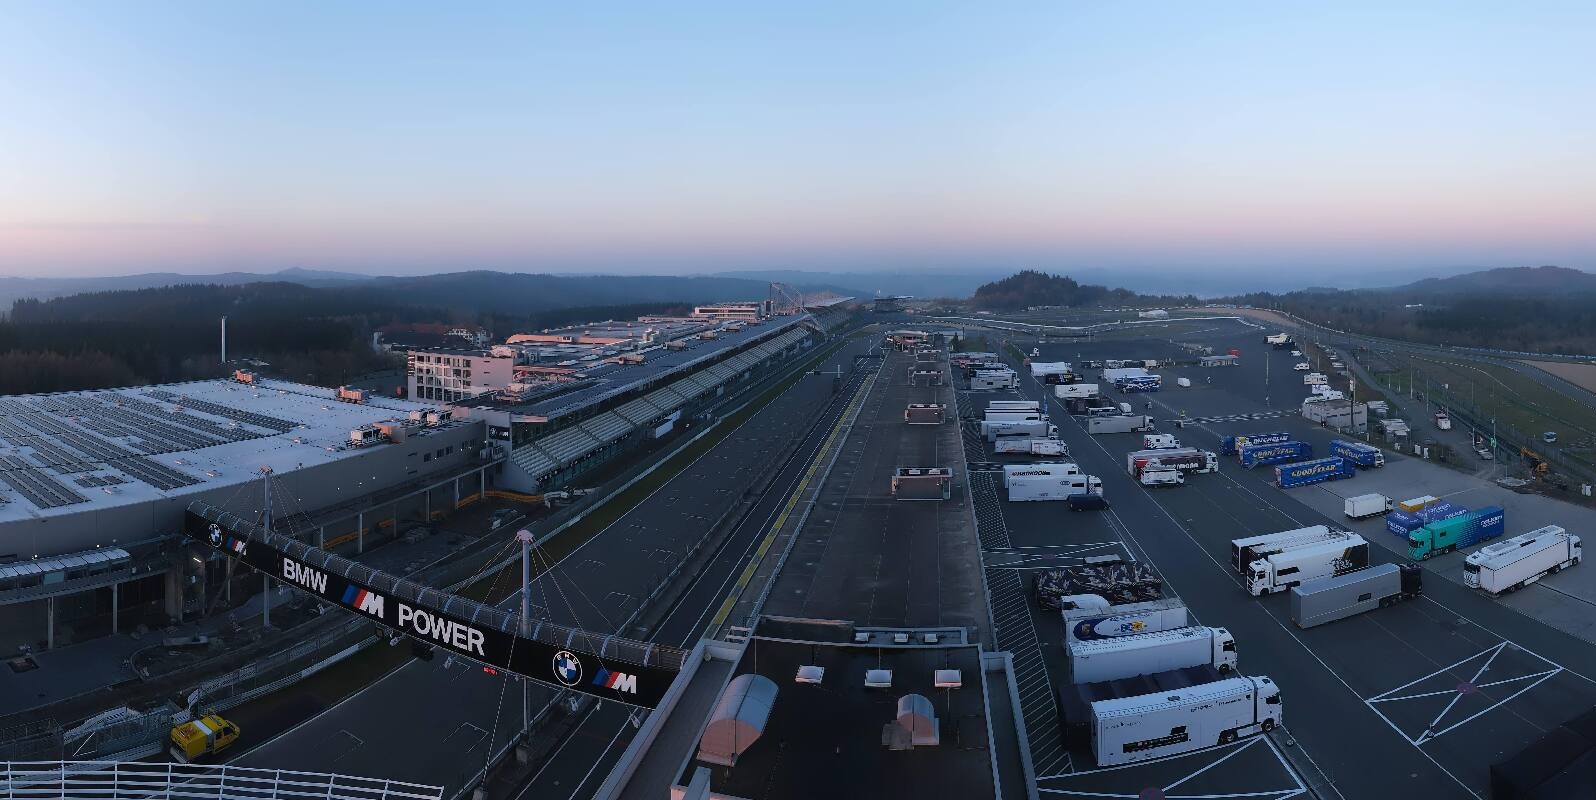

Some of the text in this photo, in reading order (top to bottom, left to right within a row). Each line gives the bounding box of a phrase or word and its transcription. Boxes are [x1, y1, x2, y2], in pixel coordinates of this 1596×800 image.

[1292, 464, 1336, 477] GOODYEAR
[283, 557, 328, 594] BMW
[398, 602, 485, 656] POWER
